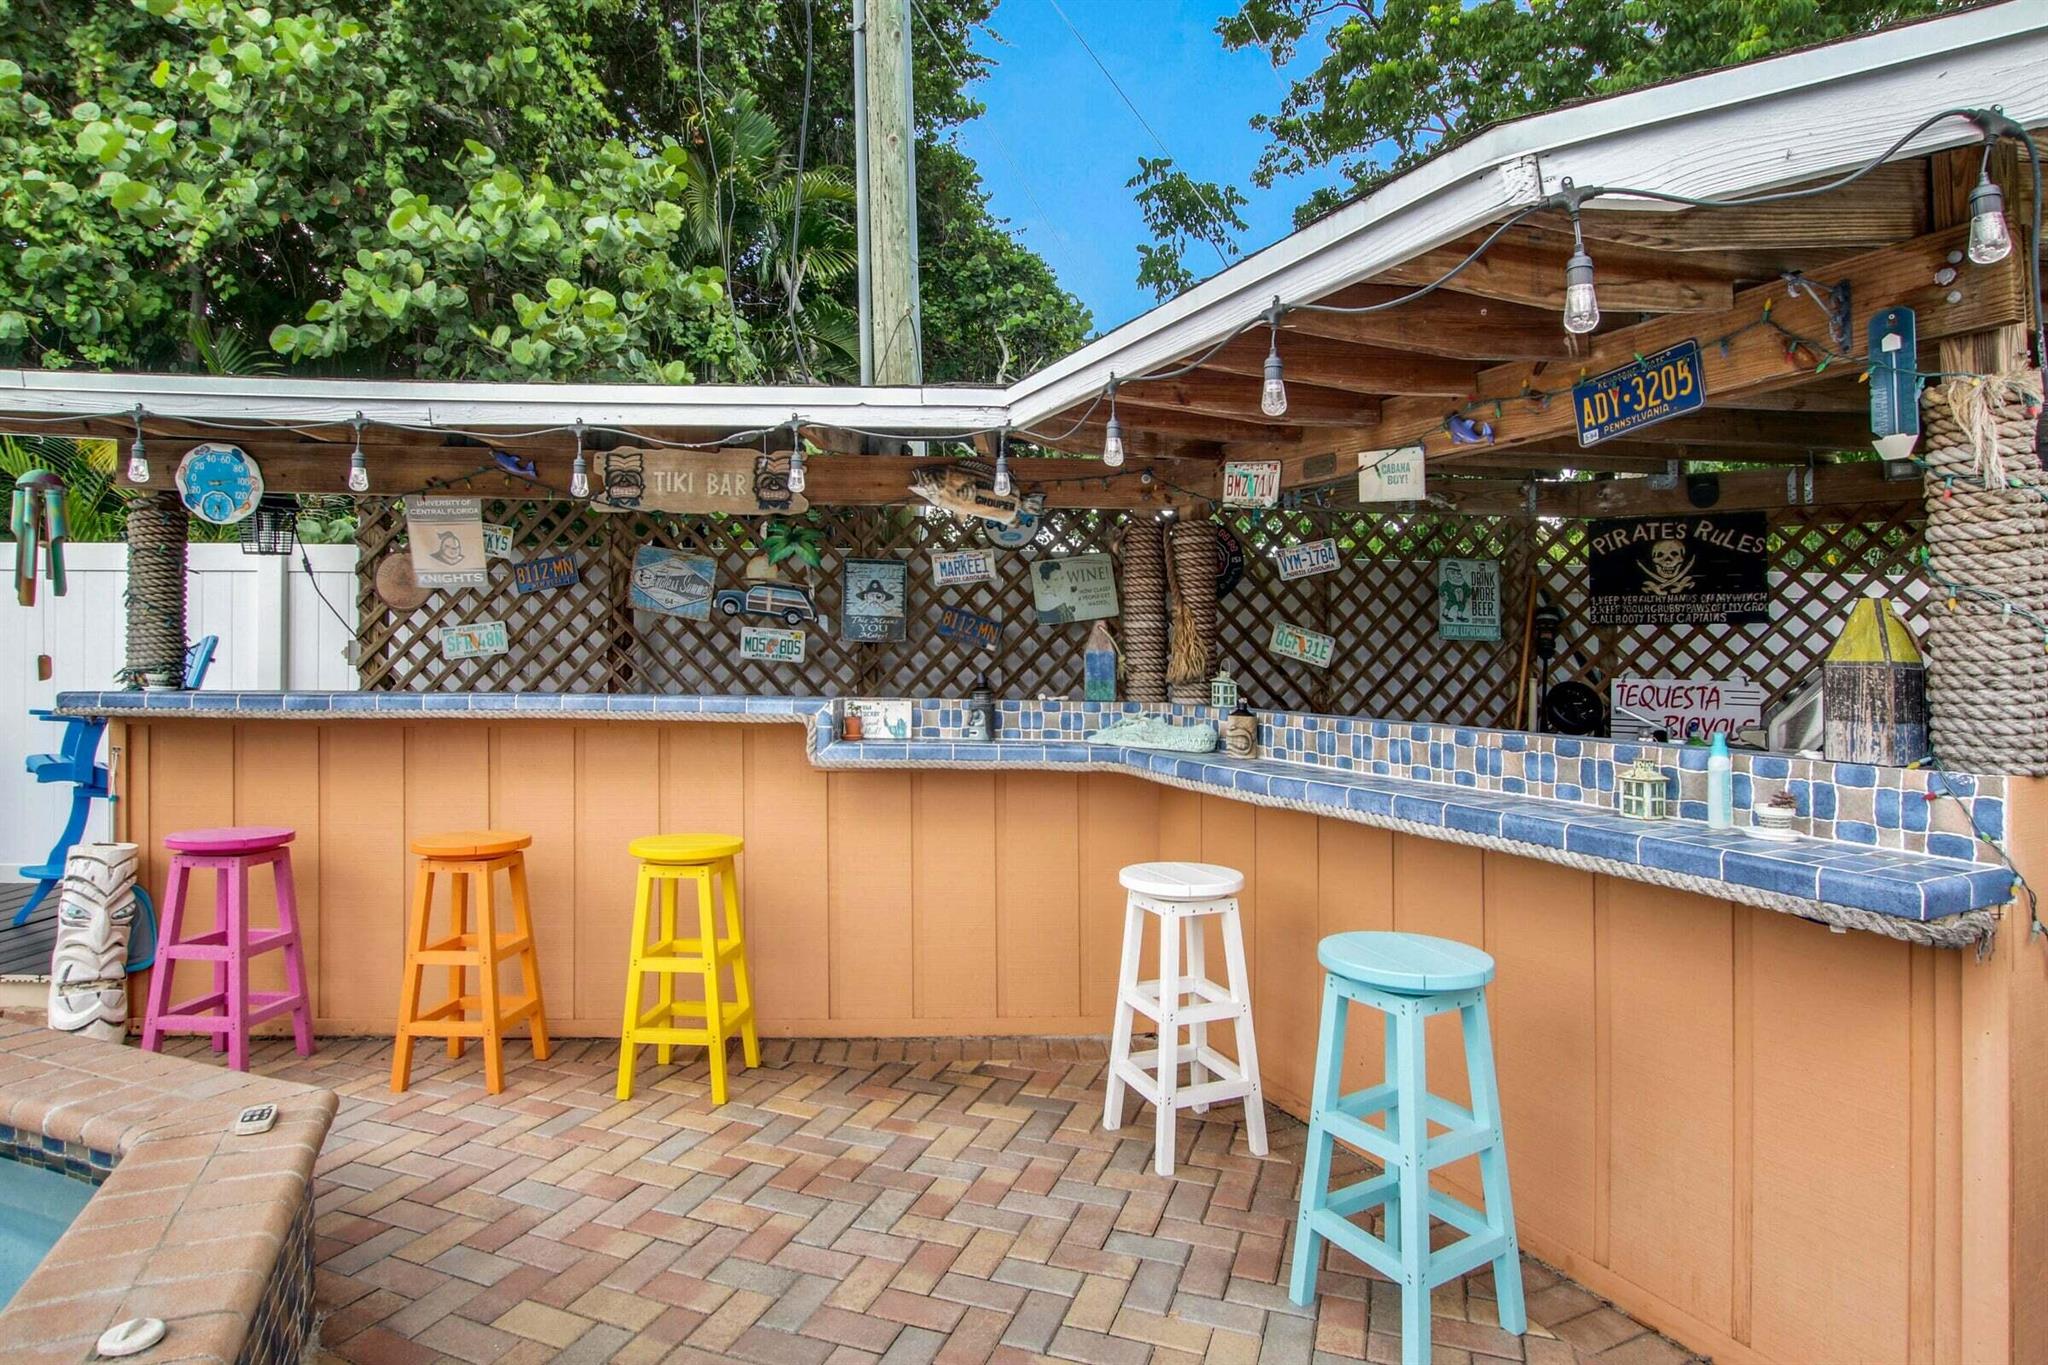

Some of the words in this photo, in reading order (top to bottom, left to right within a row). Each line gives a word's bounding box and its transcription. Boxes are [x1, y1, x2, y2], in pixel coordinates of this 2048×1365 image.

[1603, 403, 1670, 434] PENNSYLVANIA
[206, 455, 217, 463] 40
[220, 456, 231, 464] 60
[194, 462, 205, 470] 20
[233, 464, 244, 472] 80
[191, 473, 197, 482] 0
[238, 478, 250, 486] 100
[653, 471, 693, 493] TIKI
[706, 471, 747, 496] BAR
[235, 491, 248, 499] 120
[419, 572, 484, 584] KNIGHTS
[1471, 571, 1496, 586] DRINK
[1471, 587, 1496, 602] MORE
[1599, 595, 1620, 605] KEEP
[1600, 614, 1615, 624] ALL
[1616, 614, 1645, 624] BOOTY
[1647, 613, 1658, 623] IS
[860, 624, 888, 632] YOU
[1616, 684, 1721, 712] TEQUESTA
